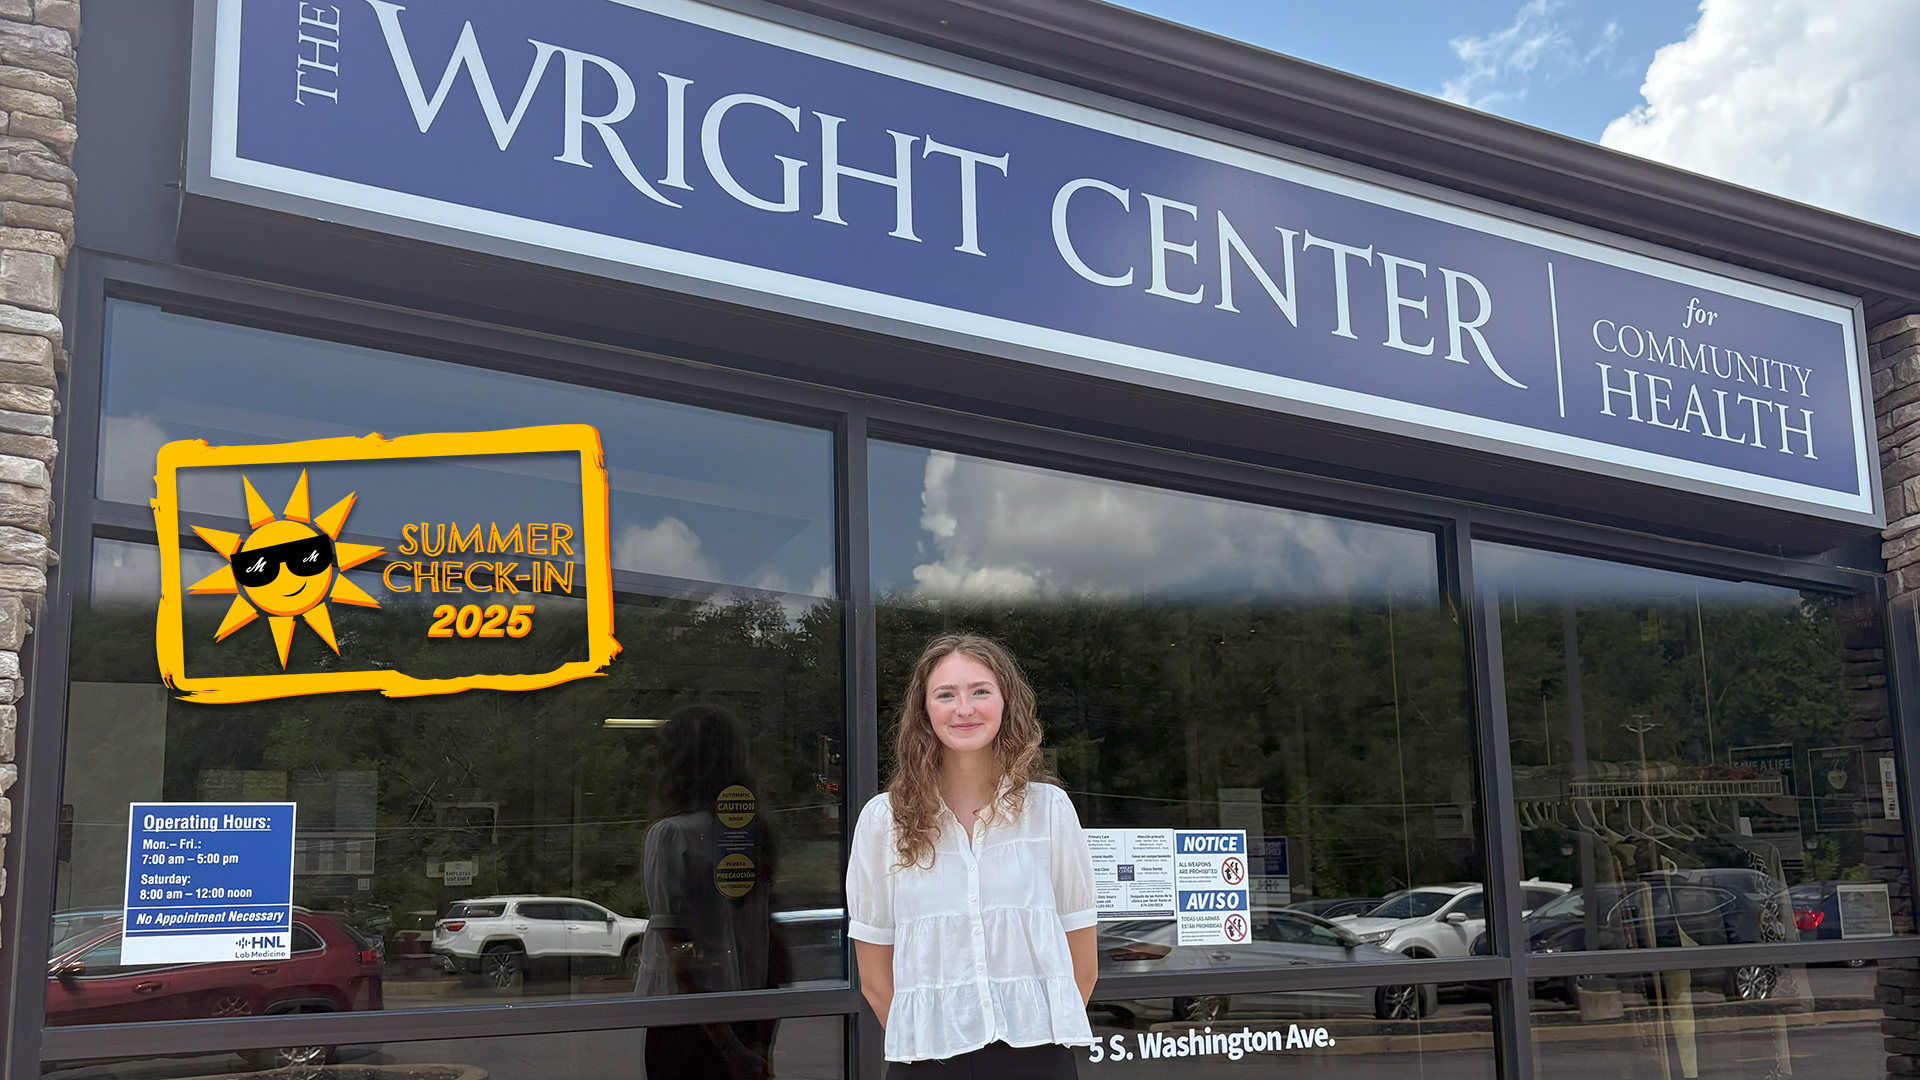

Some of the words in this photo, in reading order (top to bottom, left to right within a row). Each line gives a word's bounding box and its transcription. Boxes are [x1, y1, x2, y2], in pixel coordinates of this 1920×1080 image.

[295, 1, 340, 106] THE
[365, 0, 1010, 257] WRIGHT
[1051, 177, 1528, 391] CENTER
[1682, 297, 1718, 329] for
[1592, 319, 1813, 398] COMMUNITY
[1595, 362, 1819, 460] HEALTH
[1769, 758, 1791, 769] LIFE
[717, 802, 755, 811] CAUTION
[144, 815, 218, 832] Operating
[223, 815, 270, 829] Hours:
[180, 839, 201, 849] Fri.:
[1183, 836, 1238, 852] NOTICE
[141, 854, 165, 865] 7:00
[168, 856, 184, 864] am
[197, 854, 220, 864] 5:00
[222, 855, 239, 866] pm
[141, 874, 190, 887] Saturday:
[140, 889, 163, 900] 8:00
[166, 891, 182, 899] am
[196, 888, 224, 899] 12:00
[227, 890, 252, 898] noon
[1185, 892, 1240, 910] AVISO
[136, 913, 152, 925] No
[154, 911, 226, 927] Appointment
[228, 911, 284, 923] Necessary
[251, 936, 286, 949] HNL
[235, 951, 250, 959] Lab
[1109, 1034, 1134, 1061] S.
[1137, 1026, 1282, 1061] Washington
[1285, 1024, 1336, 1050] Ave.
